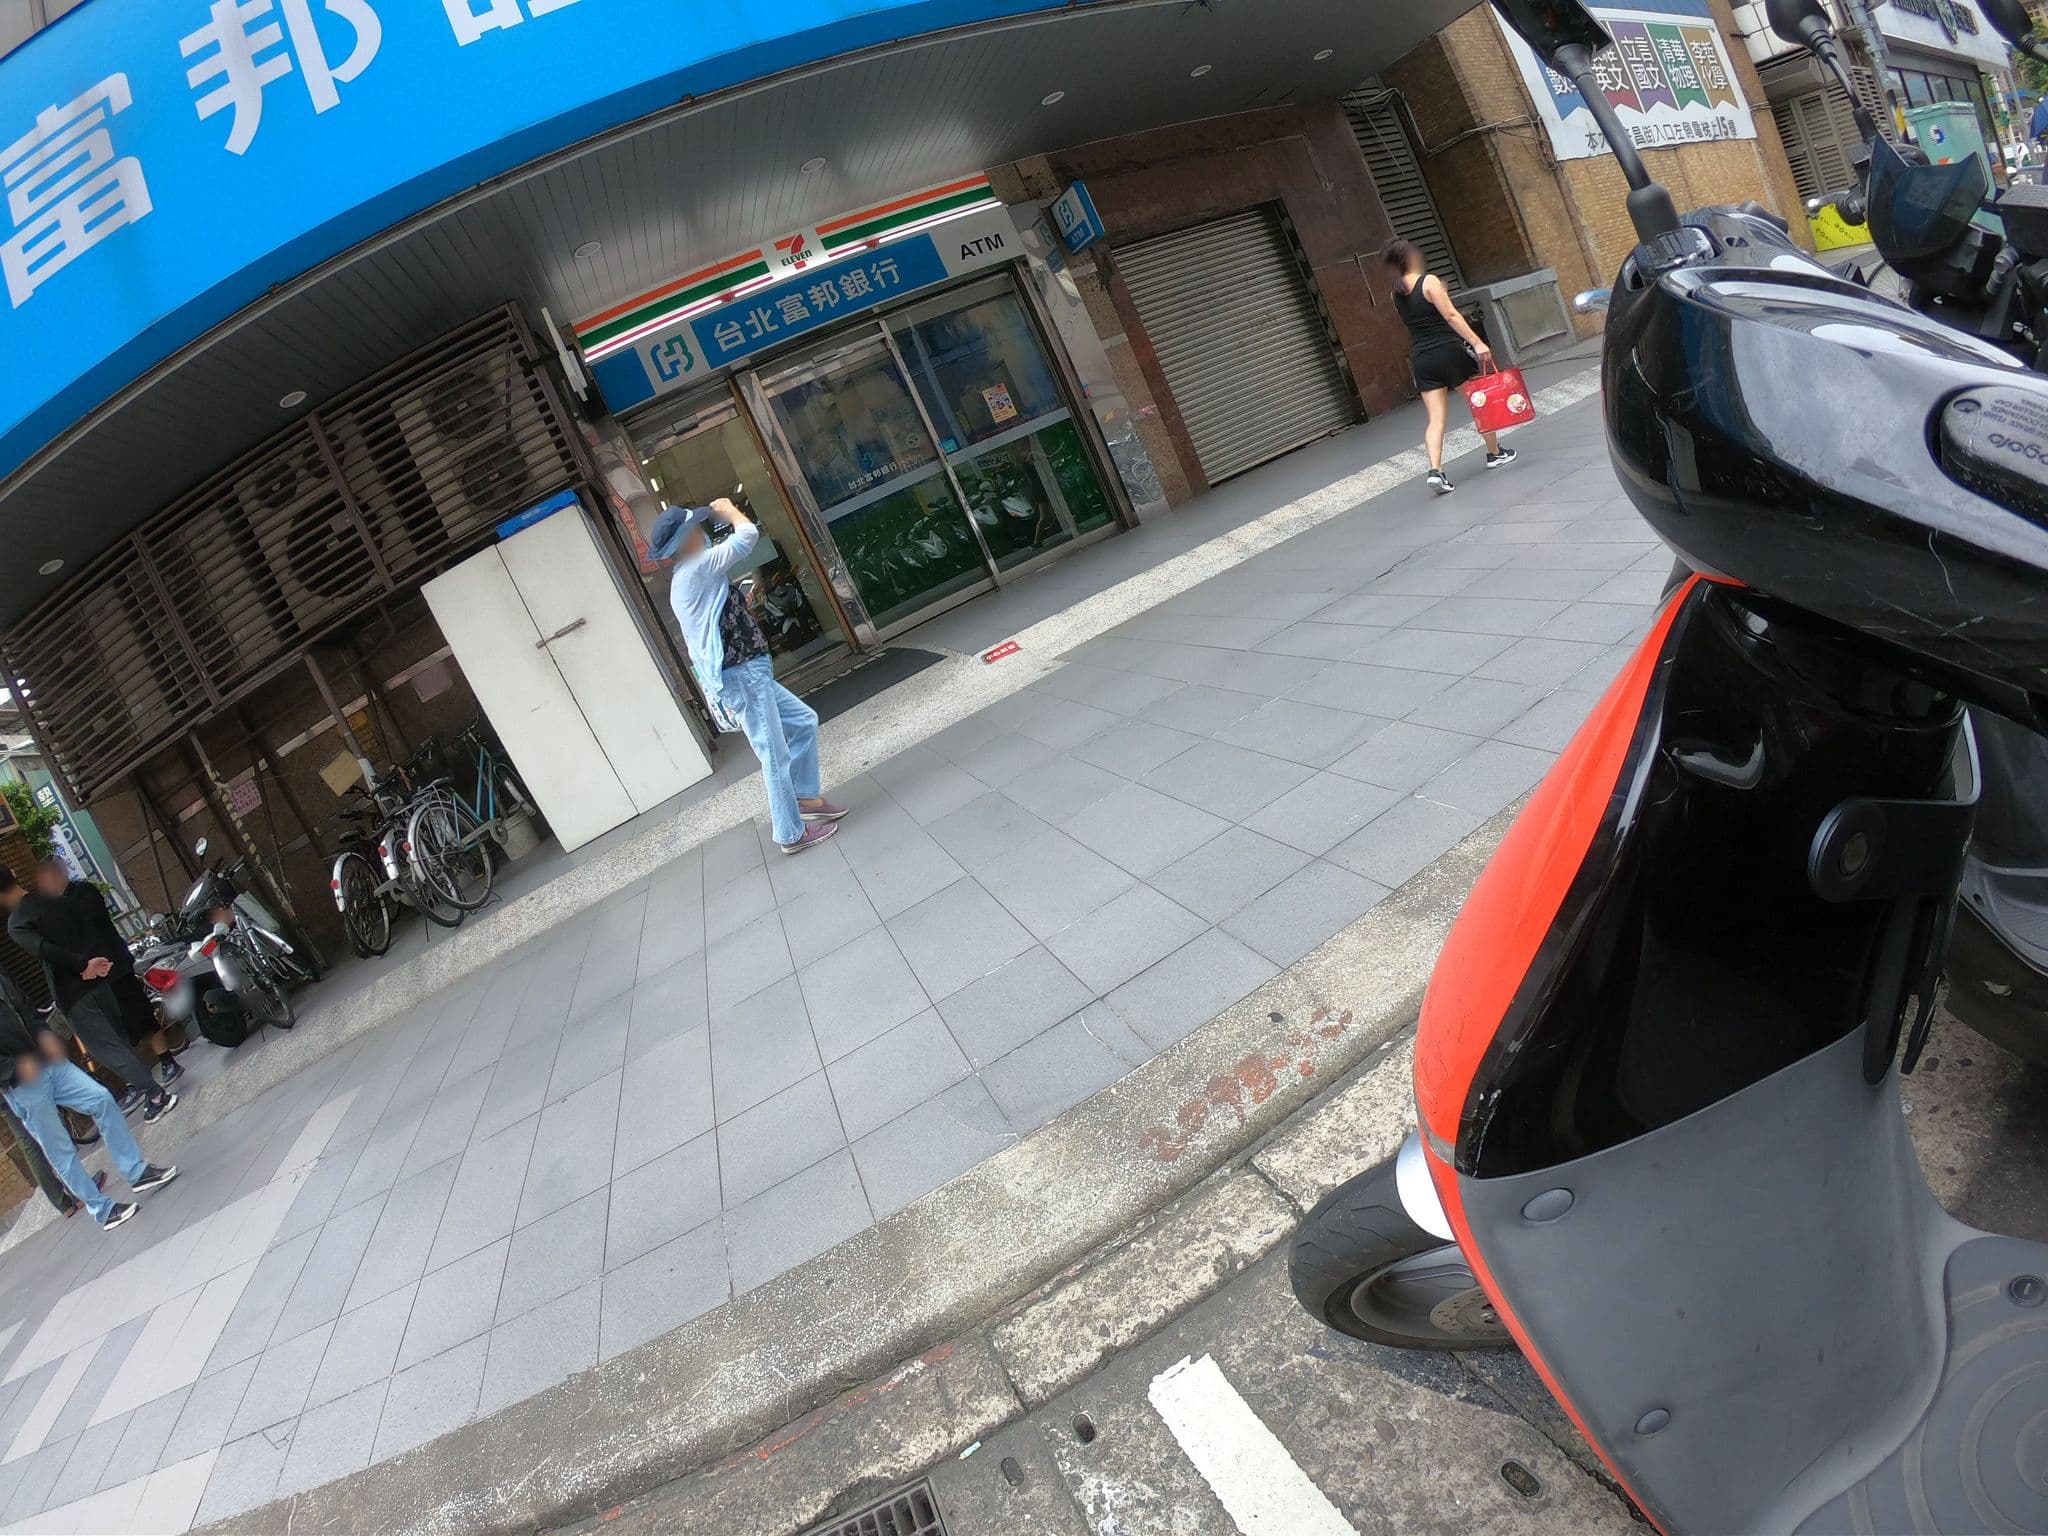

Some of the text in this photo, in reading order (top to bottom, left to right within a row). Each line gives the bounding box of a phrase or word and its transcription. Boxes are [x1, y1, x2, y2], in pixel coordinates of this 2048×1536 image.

[1621, 34, 1654, 63] 立言
[1656, 37, 1687, 64] 清華
[1689, 39, 1717, 65] 李哲
[1545, 66, 1579, 96] 數
[1592, 62, 1630, 91] 英文
[1632, 62, 1666, 91] 國文
[1671, 64, 1700, 90] 物理
[1702, 65, 1728, 91] 化學
[959, 233, 1005, 260] ATM
[1070, 227, 1086, 245] ATM
[781, 249, 813, 267] ELEVEN
[712, 256, 902, 353] 台北富邦銀行
